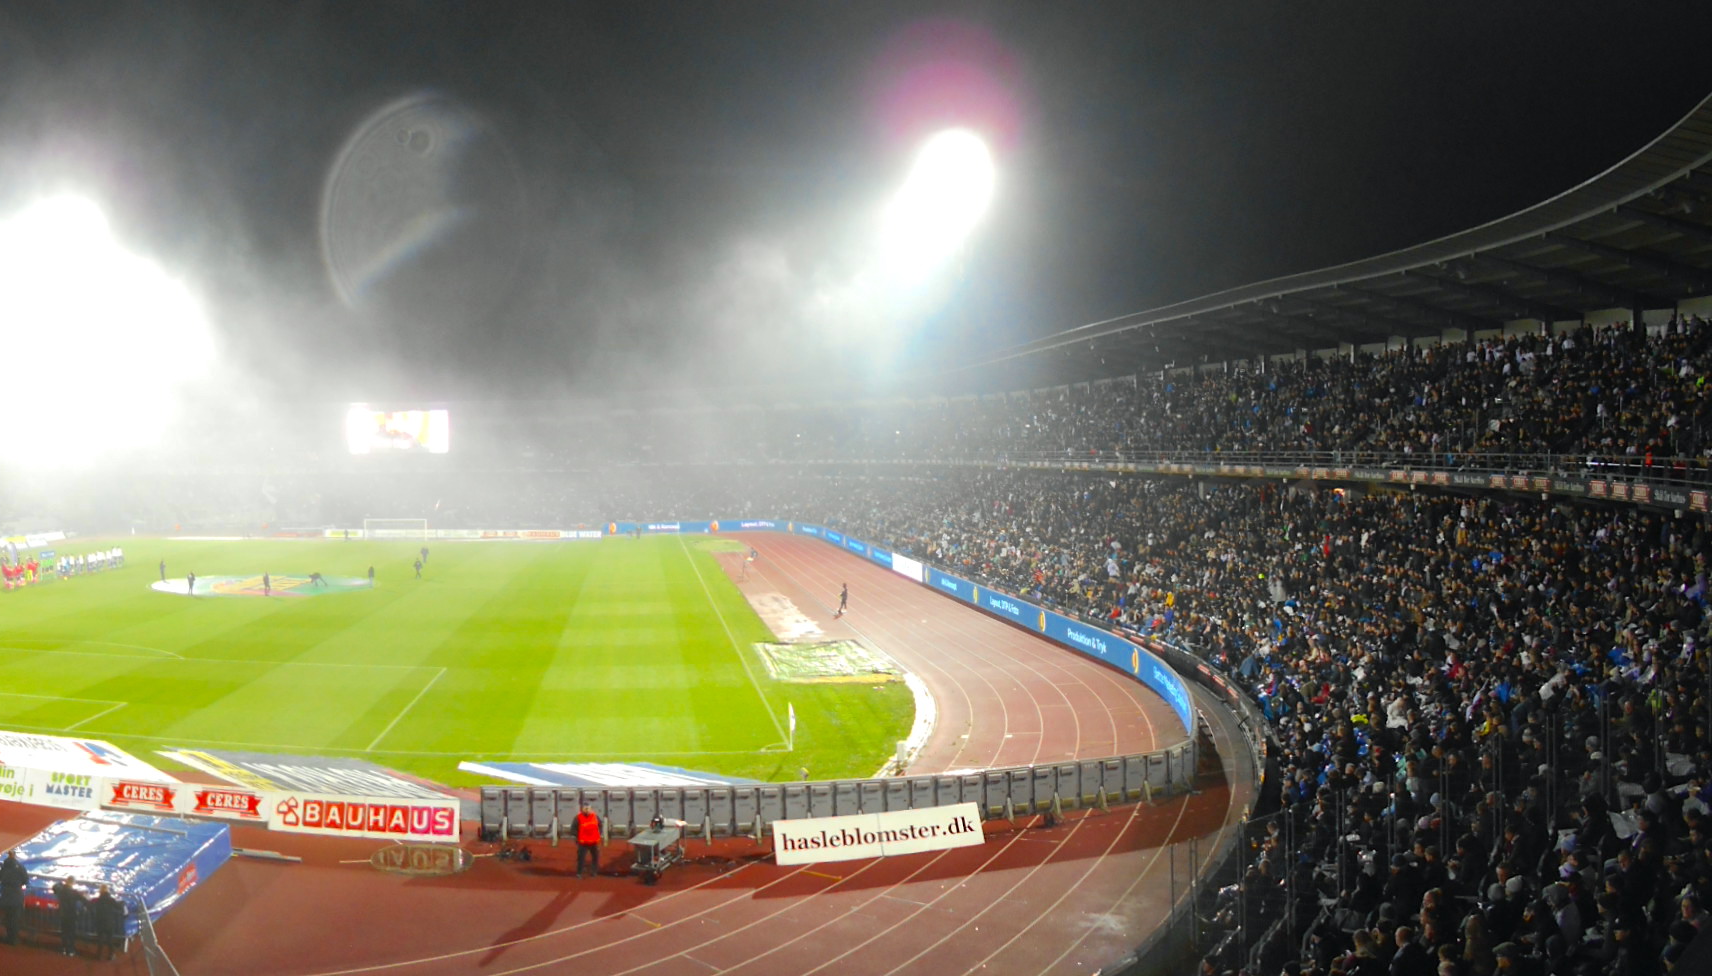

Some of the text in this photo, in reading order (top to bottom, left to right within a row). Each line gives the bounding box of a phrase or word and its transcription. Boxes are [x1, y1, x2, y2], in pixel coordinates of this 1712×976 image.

[45, 783, 94, 799] MASTER
[123, 783, 164, 802] CERES
[206, 791, 250, 810] CERES
[304, 802, 453, 833] BAUHAUS
[781, 815, 975, 852] hasleblomster.dk
